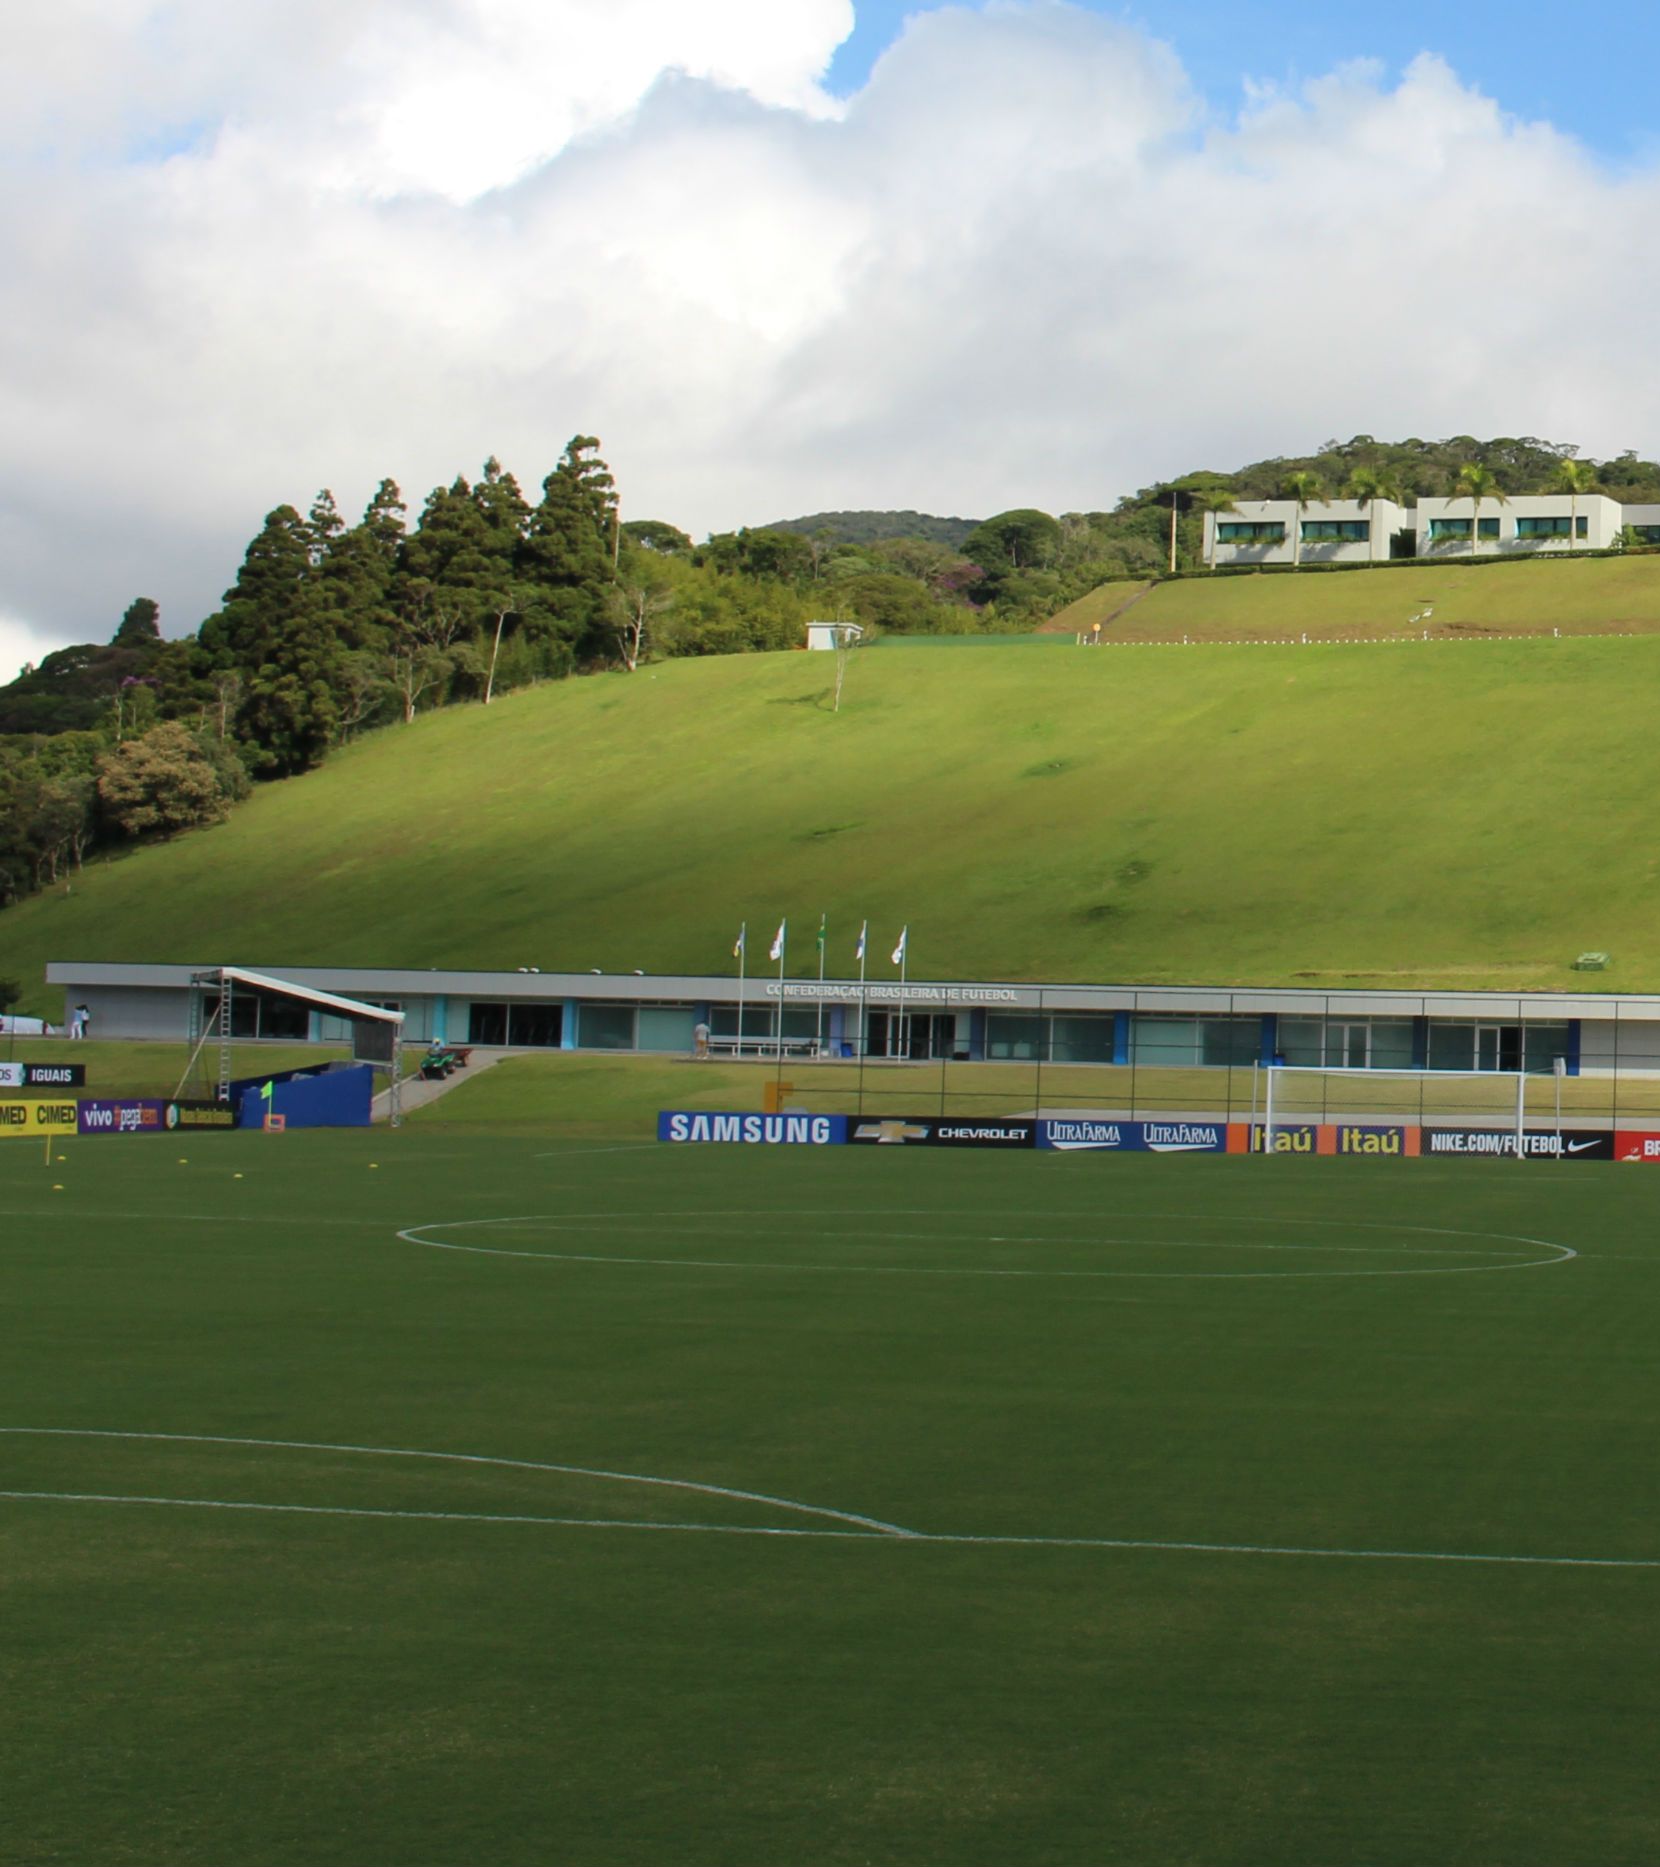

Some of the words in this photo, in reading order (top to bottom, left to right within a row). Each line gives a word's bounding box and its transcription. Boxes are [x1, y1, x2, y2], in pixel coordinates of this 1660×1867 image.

[870, 986, 938, 998] BRASILEIRA
[941, 987, 959, 999] DE
[962, 988, 1017, 1000] FUTEBOL
[31, 1069, 72, 1082] IGUAIS
[0, 1105, 27, 1125] MED
[37, 1105, 76, 1124] CIMED
[84, 1103, 113, 1127] vivo
[670, 1114, 830, 1144] SAMSUNG
[938, 1127, 1028, 1139] CHEVROLET
[1342, 1128, 1399, 1153] Itaú
